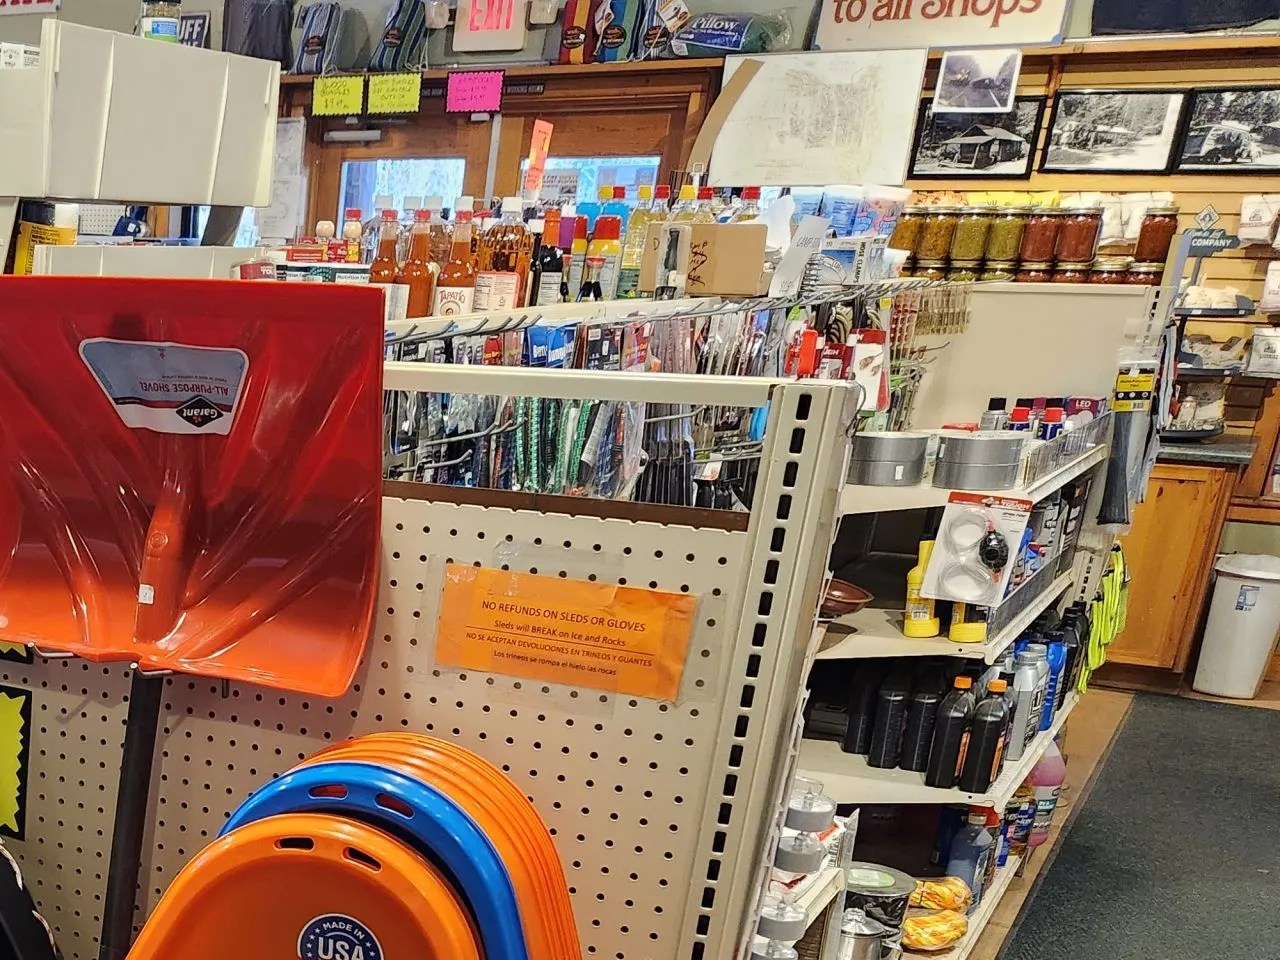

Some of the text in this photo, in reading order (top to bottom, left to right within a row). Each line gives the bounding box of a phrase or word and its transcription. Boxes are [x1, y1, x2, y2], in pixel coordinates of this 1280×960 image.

[470, 0, 513, 31] EXIT
[833, 0, 867, 23] to
[692, 16, 738, 30] Pillow
[1192, 238, 1232, 247] COMPANY
[139, 381, 229, 396] ALL-PURPOSE SHOVEL
[182, 408, 218, 418] Garant
[1075, 399, 1091, 408] LED
[482, 601, 646, 632] NO REFUNDS ON SLEDS OR GLOVES
[494, 620, 514, 631] Sleds
[516, 622, 530, 633] will
[531, 626, 557, 637] BREAK
[559, 631, 569, 639] on
[584, 632, 600, 643] and
[602, 635, 626, 646] Rocks
[466, 632, 476, 640] NO
[487, 635, 517, 646] ACEPTAN
[518, 640, 569, 654] DEVOLUCIONES
[570, 647, 580, 656] EN
[582, 649, 611, 661] TRINEOS
[618, 655, 652, 667] GUANTES
[494, 650, 504, 658] Los
[505, 651, 528, 662] trineos
[538, 657, 560, 668] rompa
[598, 667, 617, 675] rocas
[322, 921, 366, 940] MADE IN
